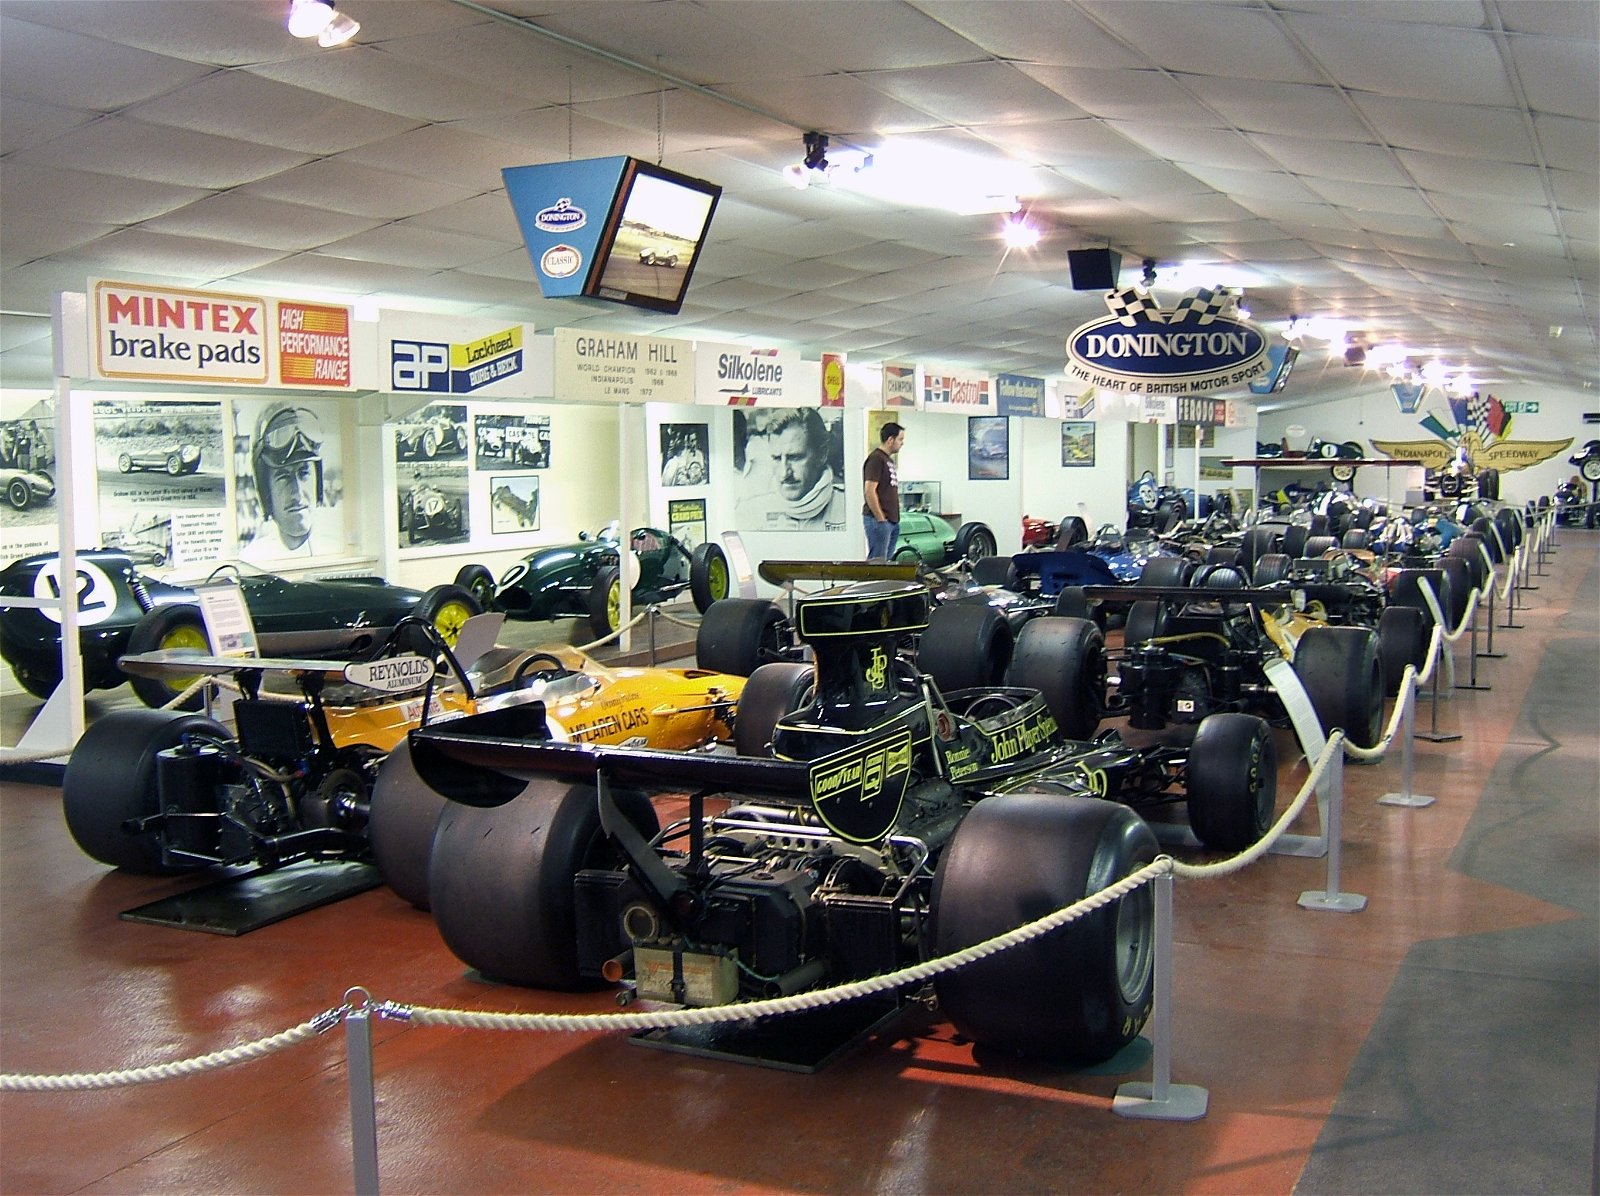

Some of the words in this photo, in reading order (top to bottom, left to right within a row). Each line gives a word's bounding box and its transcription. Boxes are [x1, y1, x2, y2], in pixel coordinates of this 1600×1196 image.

[541, 213, 580, 222] DONINGTON
[547, 255, 574, 266] CLASSIC
[107, 294, 258, 335] MINTEX
[280, 308, 305, 330] HIGH
[110, 330, 191, 361] brake
[197, 337, 261, 369] pads
[280, 331, 348, 357] PERFORMANCE
[466, 332, 513, 363] Lockheed
[576, 337, 638, 361] GRAHAM
[649, 344, 677, 363] HILL
[1086, 332, 1248, 358] DONINGTON
[314, 359, 348, 382] RANGE
[469, 369, 491, 387] BORG
[490, 364, 497, 378] &
[496, 356, 519, 377] BECK
[577, 364, 601, 373] WORLD
[604, 365, 636, 375] CHAMPION
[718, 353, 783, 383] Silkolene
[1071, 366, 1090, 382] THE
[1092, 374, 1125, 391] HEART
[1129, 382, 1142, 393] OF
[1146, 382, 1187, 394] BRITISH
[1190, 376, 1229, 392] MOTOR
[1232, 361, 1267, 384] SPORT
[591, 375, 634, 385] INDIANAPOLIS
[604, 387, 611, 395] LE
[613, 387, 630, 395] MANS
[752, 386, 782, 397] LUBRICANTS
[826, 375, 840, 387] SHELL
[887, 380, 912, 394] CHAMPION
[949, 376, 980, 406] Castrol
[1178, 397, 1214, 422] FERODO
[1488, 449, 1539, 460] SPEEDWAY
[428, 500, 438, 512] 17
[369, 659, 430, 682] REYNOLDS
[386, 675, 423, 690] ALUMINUM
[622, 707, 649, 731] CARS
[991, 732, 1018, 764] John
[1016, 722, 1040, 753] Player
[945, 746, 971, 765] Ronnie
[816, 764, 861, 795] GOODYEAR
[949, 761, 979, 779] Peterson
